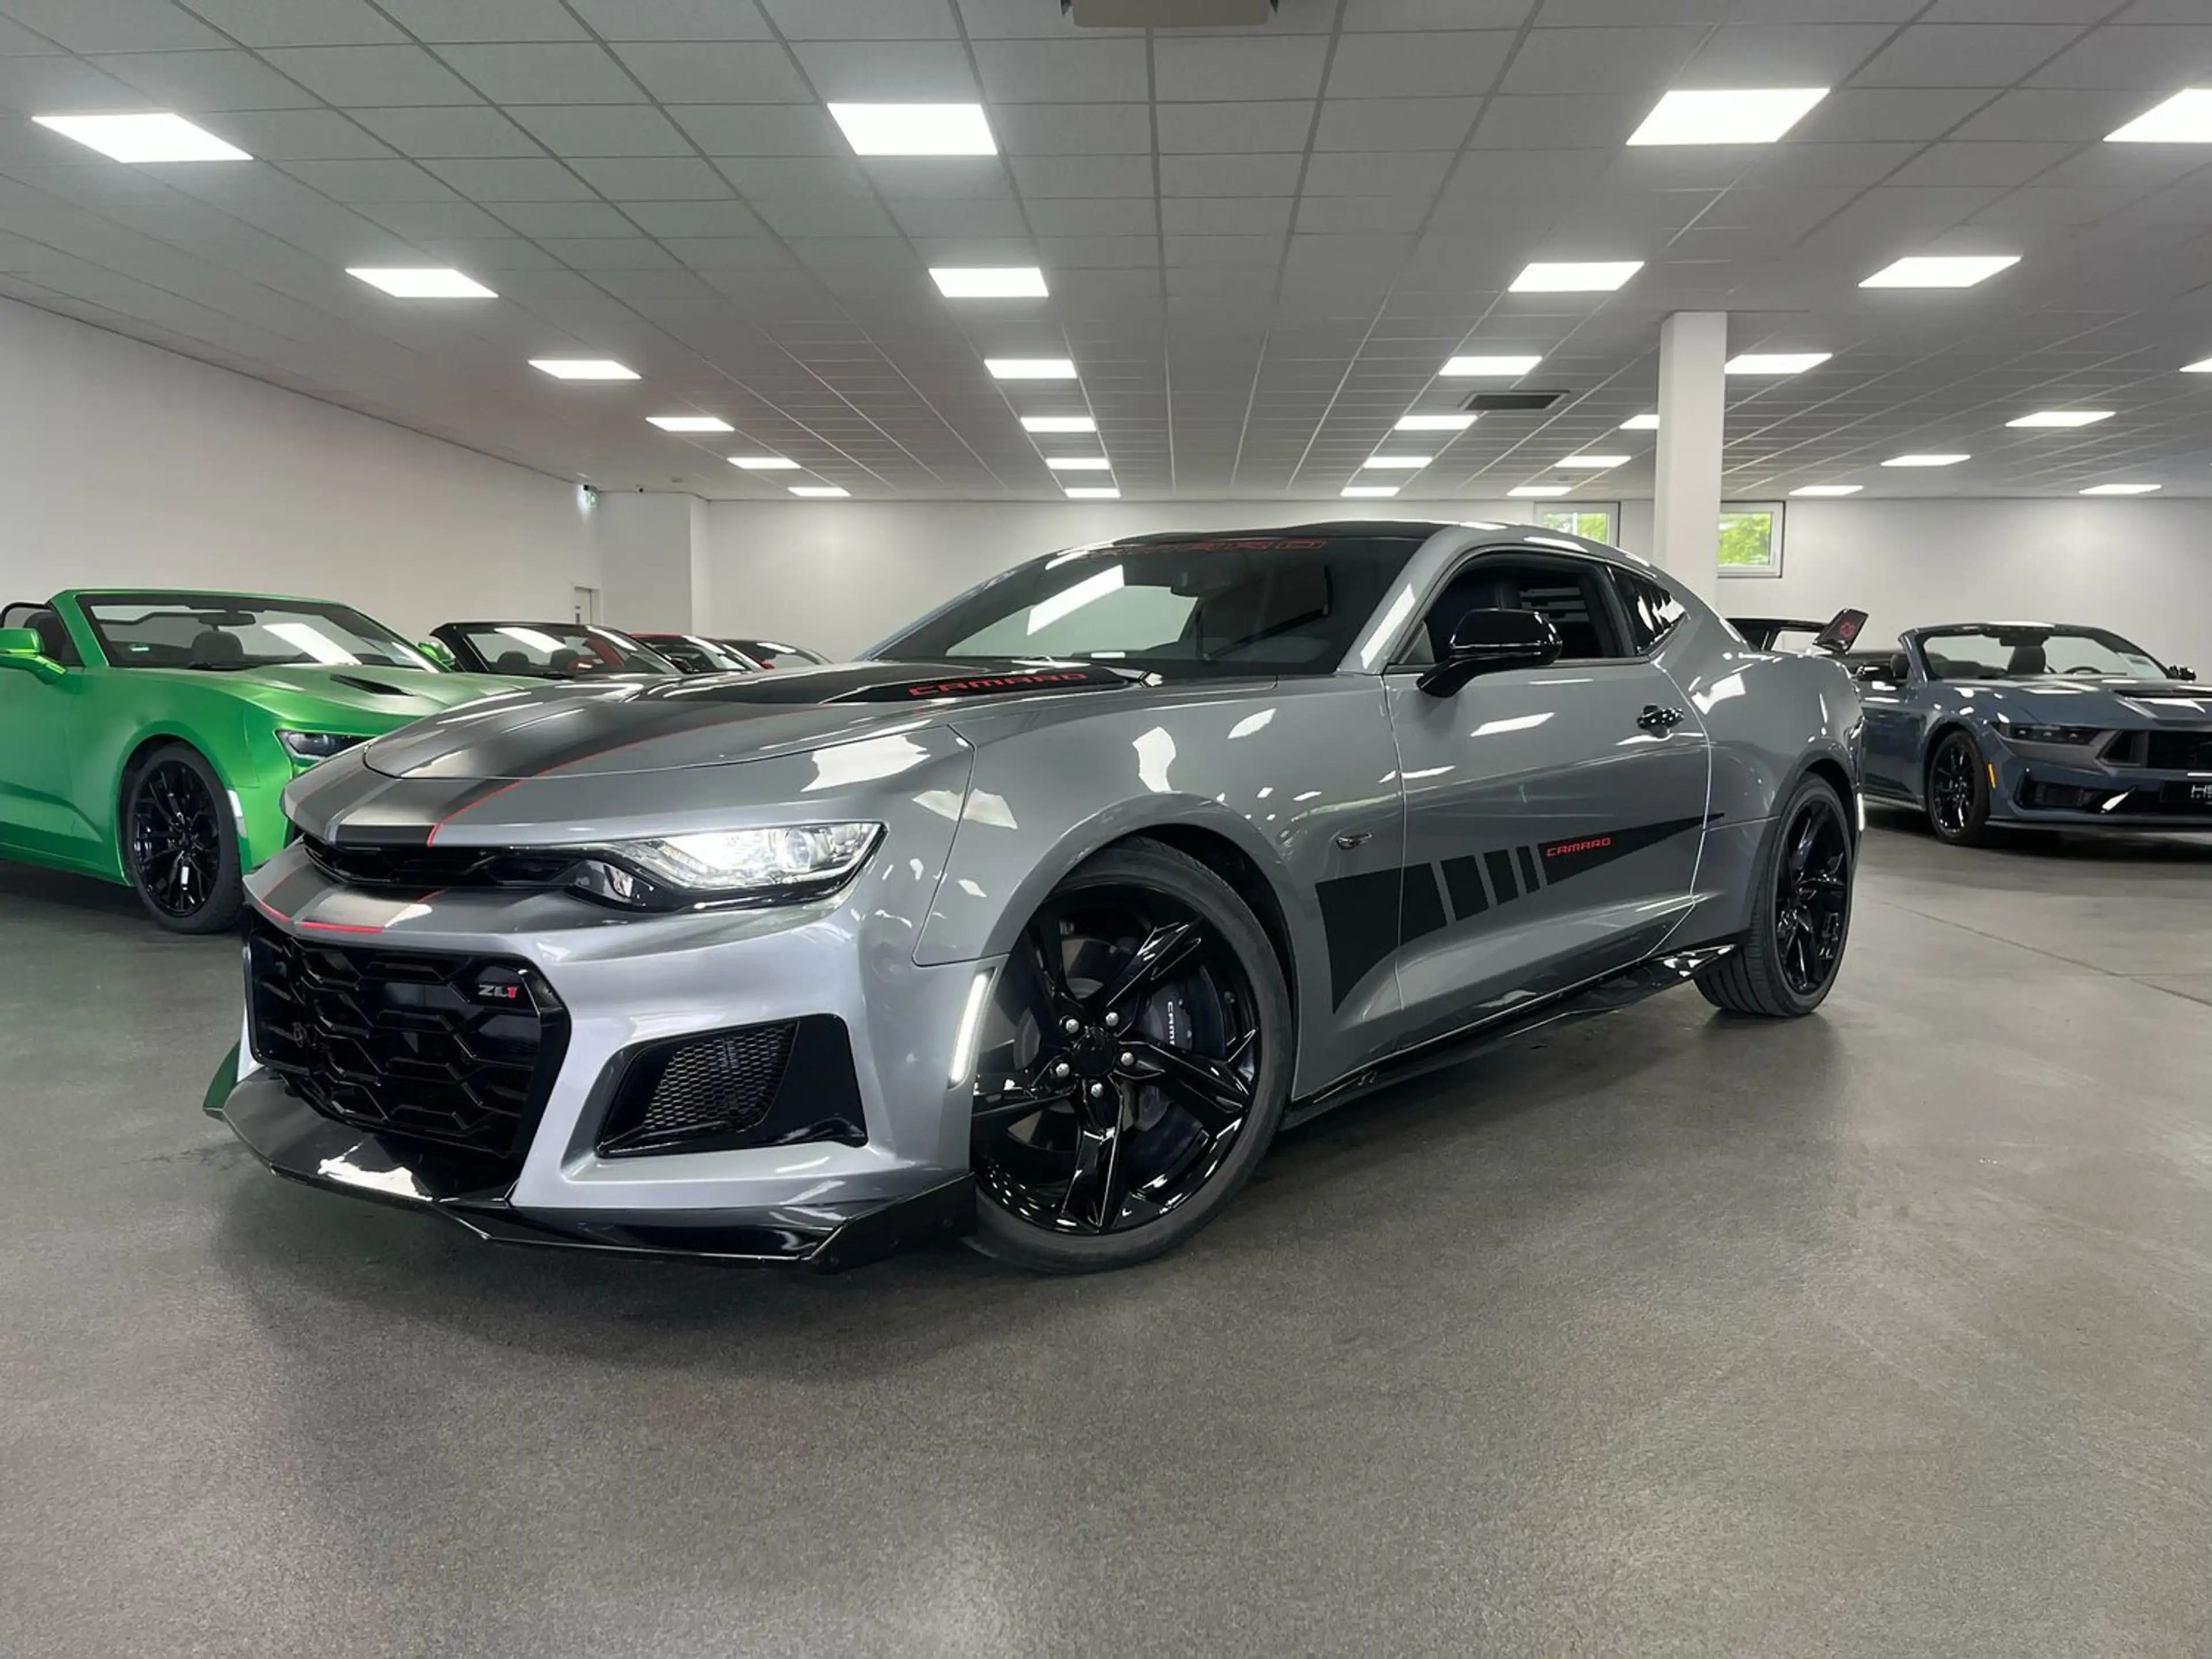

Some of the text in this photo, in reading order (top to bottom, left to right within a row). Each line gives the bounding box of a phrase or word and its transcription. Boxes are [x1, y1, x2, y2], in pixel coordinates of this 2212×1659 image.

[908, 673, 1087, 696] CAMARO
[1547, 838, 1611, 857] CAMARO
[479, 984, 517, 998] ZL1
